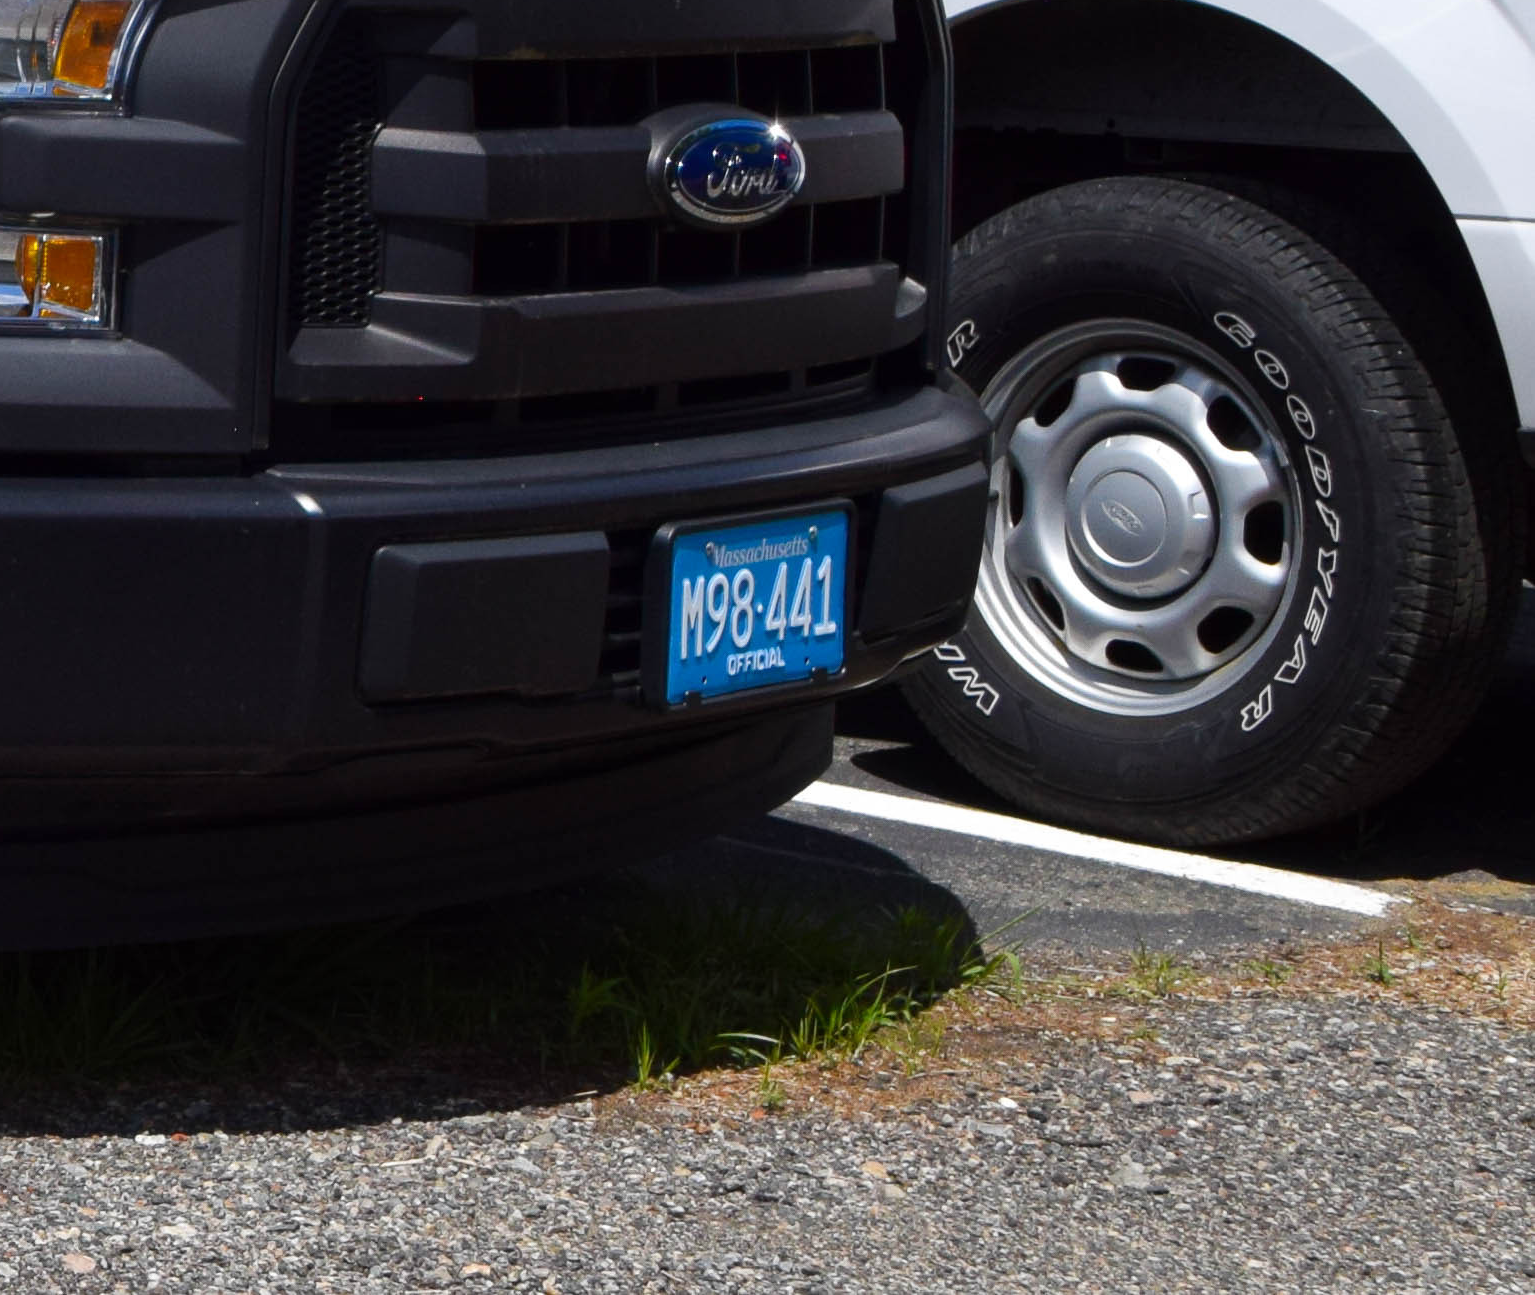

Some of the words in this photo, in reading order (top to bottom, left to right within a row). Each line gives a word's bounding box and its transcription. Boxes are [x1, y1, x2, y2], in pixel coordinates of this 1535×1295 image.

[706, 144, 789, 198] Ford
[1213, 312, 1339, 731] GOODYEAR
[712, 536, 809, 568] Massachusetts
[727, 647, 786, 676] OFFICIAL
